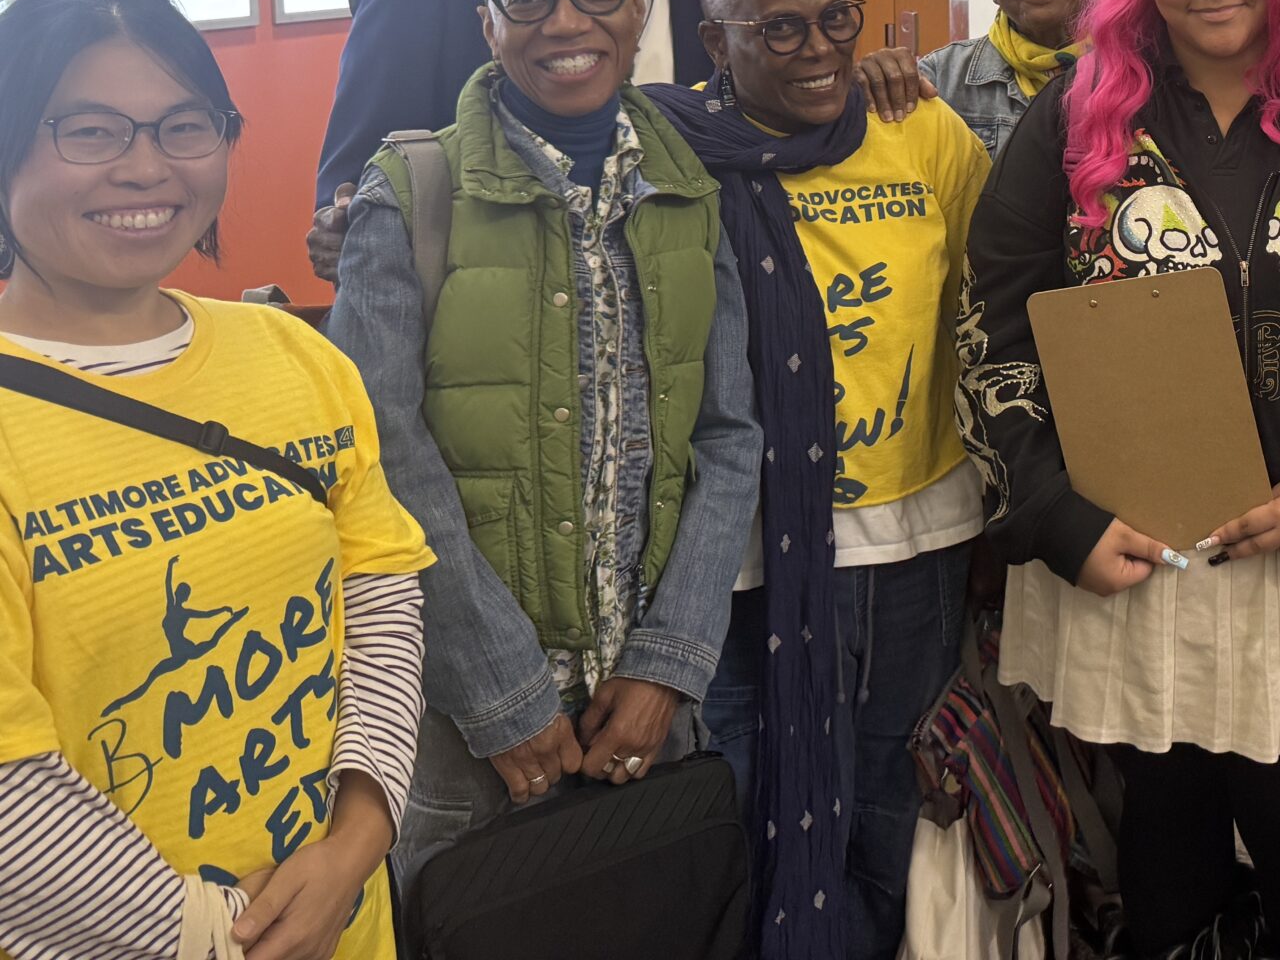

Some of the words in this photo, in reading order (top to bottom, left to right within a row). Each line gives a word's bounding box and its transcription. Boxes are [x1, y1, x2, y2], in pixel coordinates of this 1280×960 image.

[797, 181, 924, 205] ADVOCATES
[24, 474, 187, 540] ALTIMORE
[187, 434, 336, 493] ADVATES
[33, 518, 153, 583] ARTS
[150, 461, 339, 542] EDUCAN
